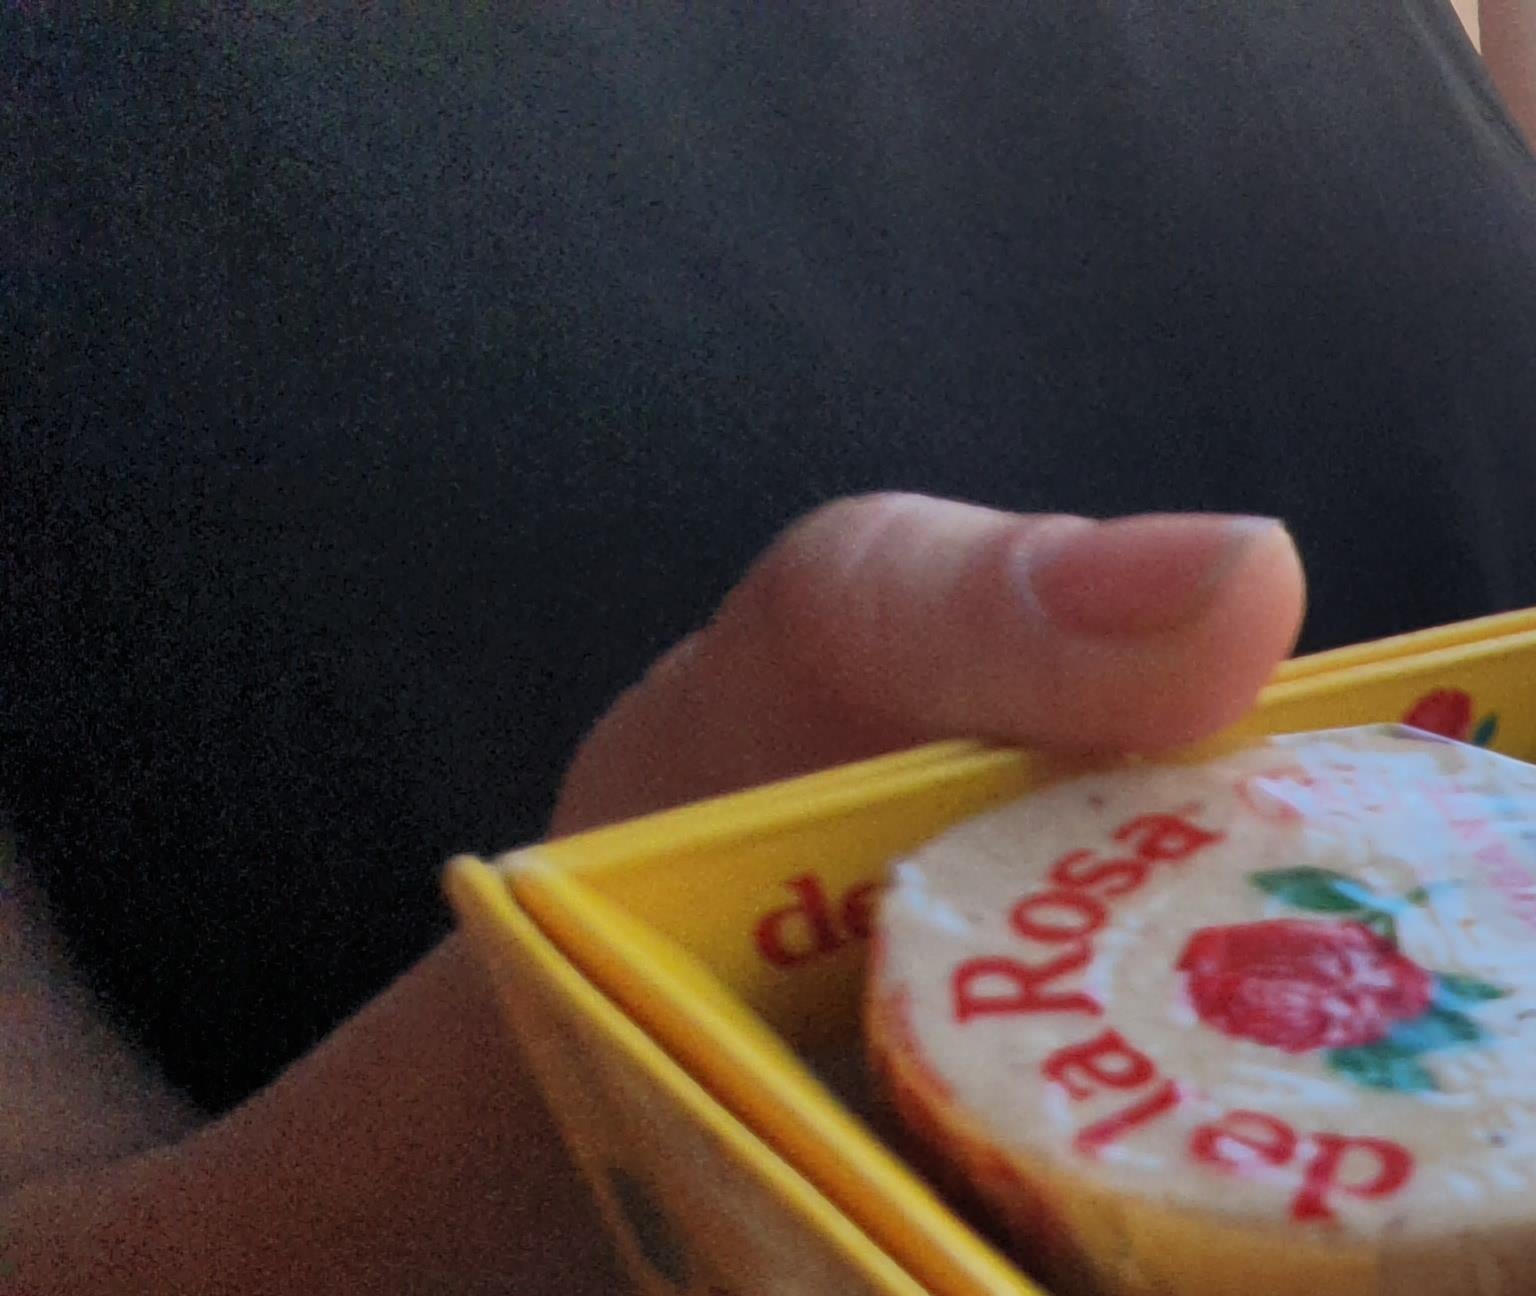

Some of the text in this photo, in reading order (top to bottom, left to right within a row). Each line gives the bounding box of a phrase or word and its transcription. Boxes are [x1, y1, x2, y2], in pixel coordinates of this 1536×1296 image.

[950, 810, 1416, 1222] de la Rosa
